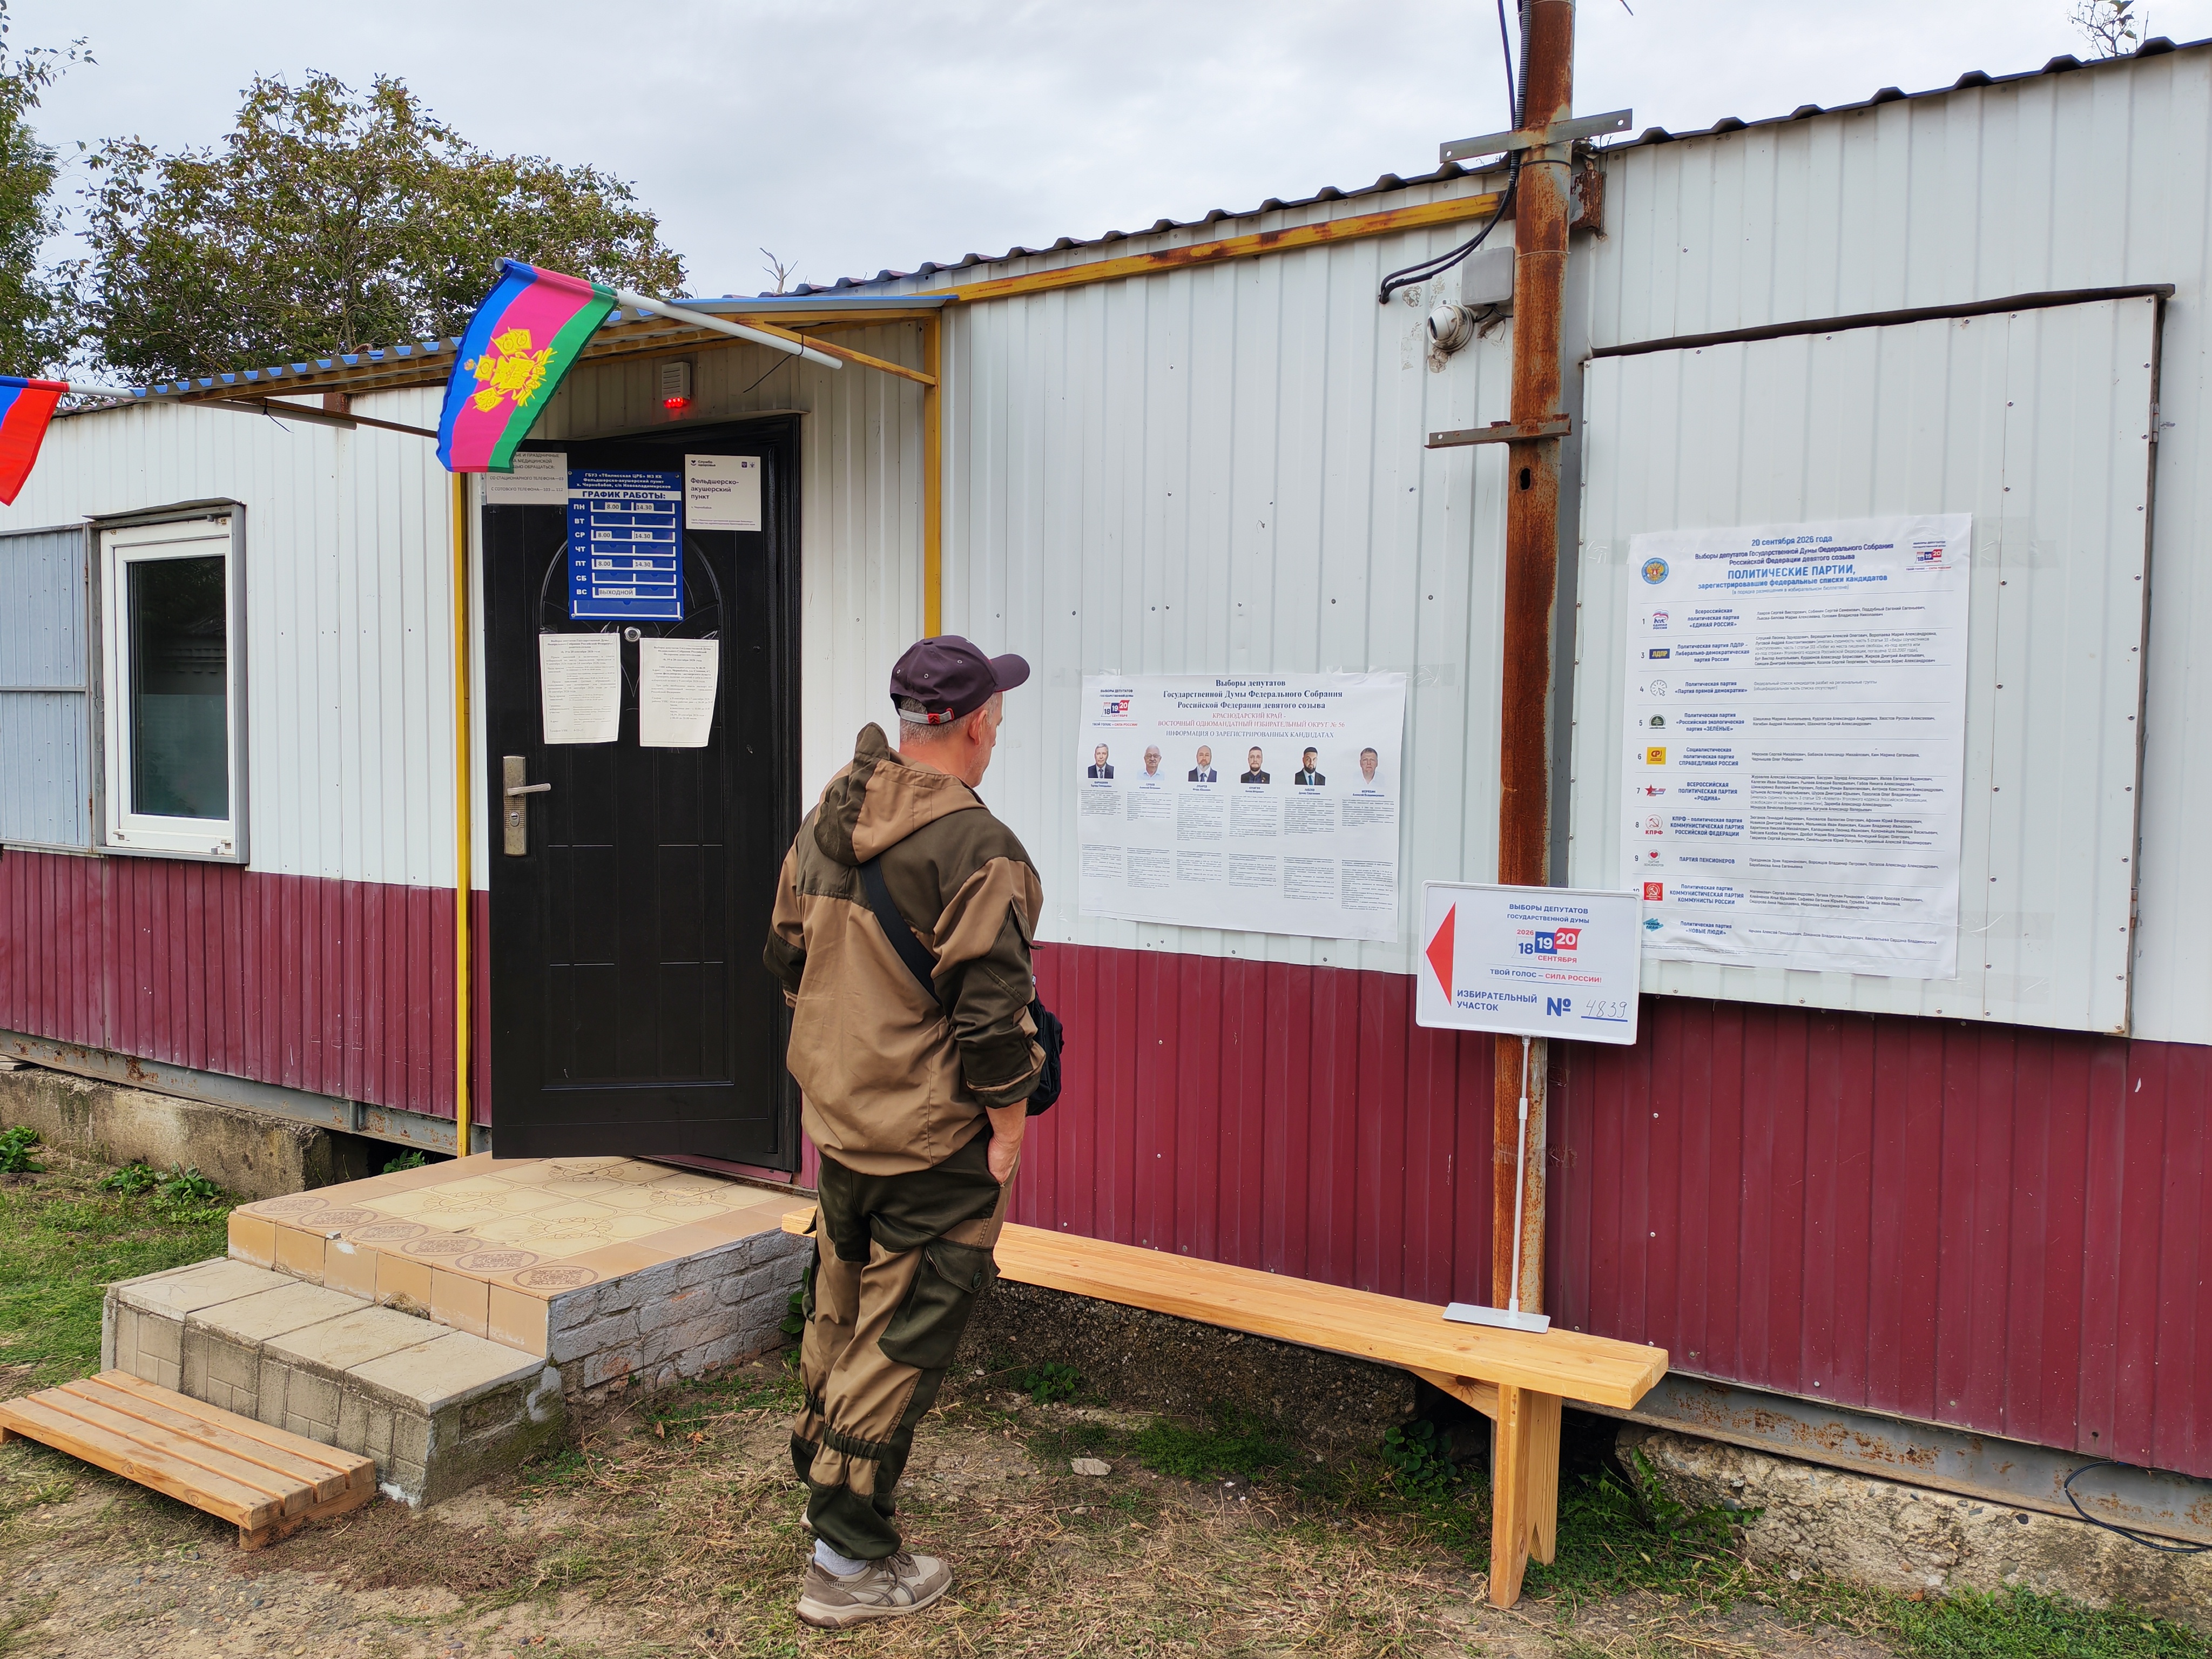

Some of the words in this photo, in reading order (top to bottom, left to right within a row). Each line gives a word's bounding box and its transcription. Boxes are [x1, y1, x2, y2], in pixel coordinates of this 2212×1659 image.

[1762, 537, 1795, 546] сентября
[1749, 548, 1798, 557] Государственной
[1818, 544, 1862, 553] Федерального
[1728, 567, 1808, 579] ПОЛИТИЧЕСКИЕ
[1812, 564, 1856, 575] ПАРТИИ,
[1698, 580, 1768, 590] зарегистрировавшие
[1769, 577, 1817, 586] федеральные
[1216, 679, 1246, 687] Выборы
[1164, 691, 1223, 699] Государственной
[1225, 691, 1246, 699] Думы
[1249, 691, 1301, 699] Федерального
[1304, 690, 1342, 699] Собрания
[1220, 702, 1261, 710] Федерации
[1507, 914, 1568, 922] ГОСУДАРСТВЕННОЙ
[1537, 938, 1553, 949] 19
[1556, 933, 1575, 945] 20
[1519, 943, 1533, 954] 18
[1457, 989, 1537, 1003] ИЗБИРАТЕЛЬНЫЙ
[1457, 1001, 1498, 1011] УЧАСТОК
[1547, 997, 1570, 1016] №
[1586, 999, 1627, 1017] 4839
